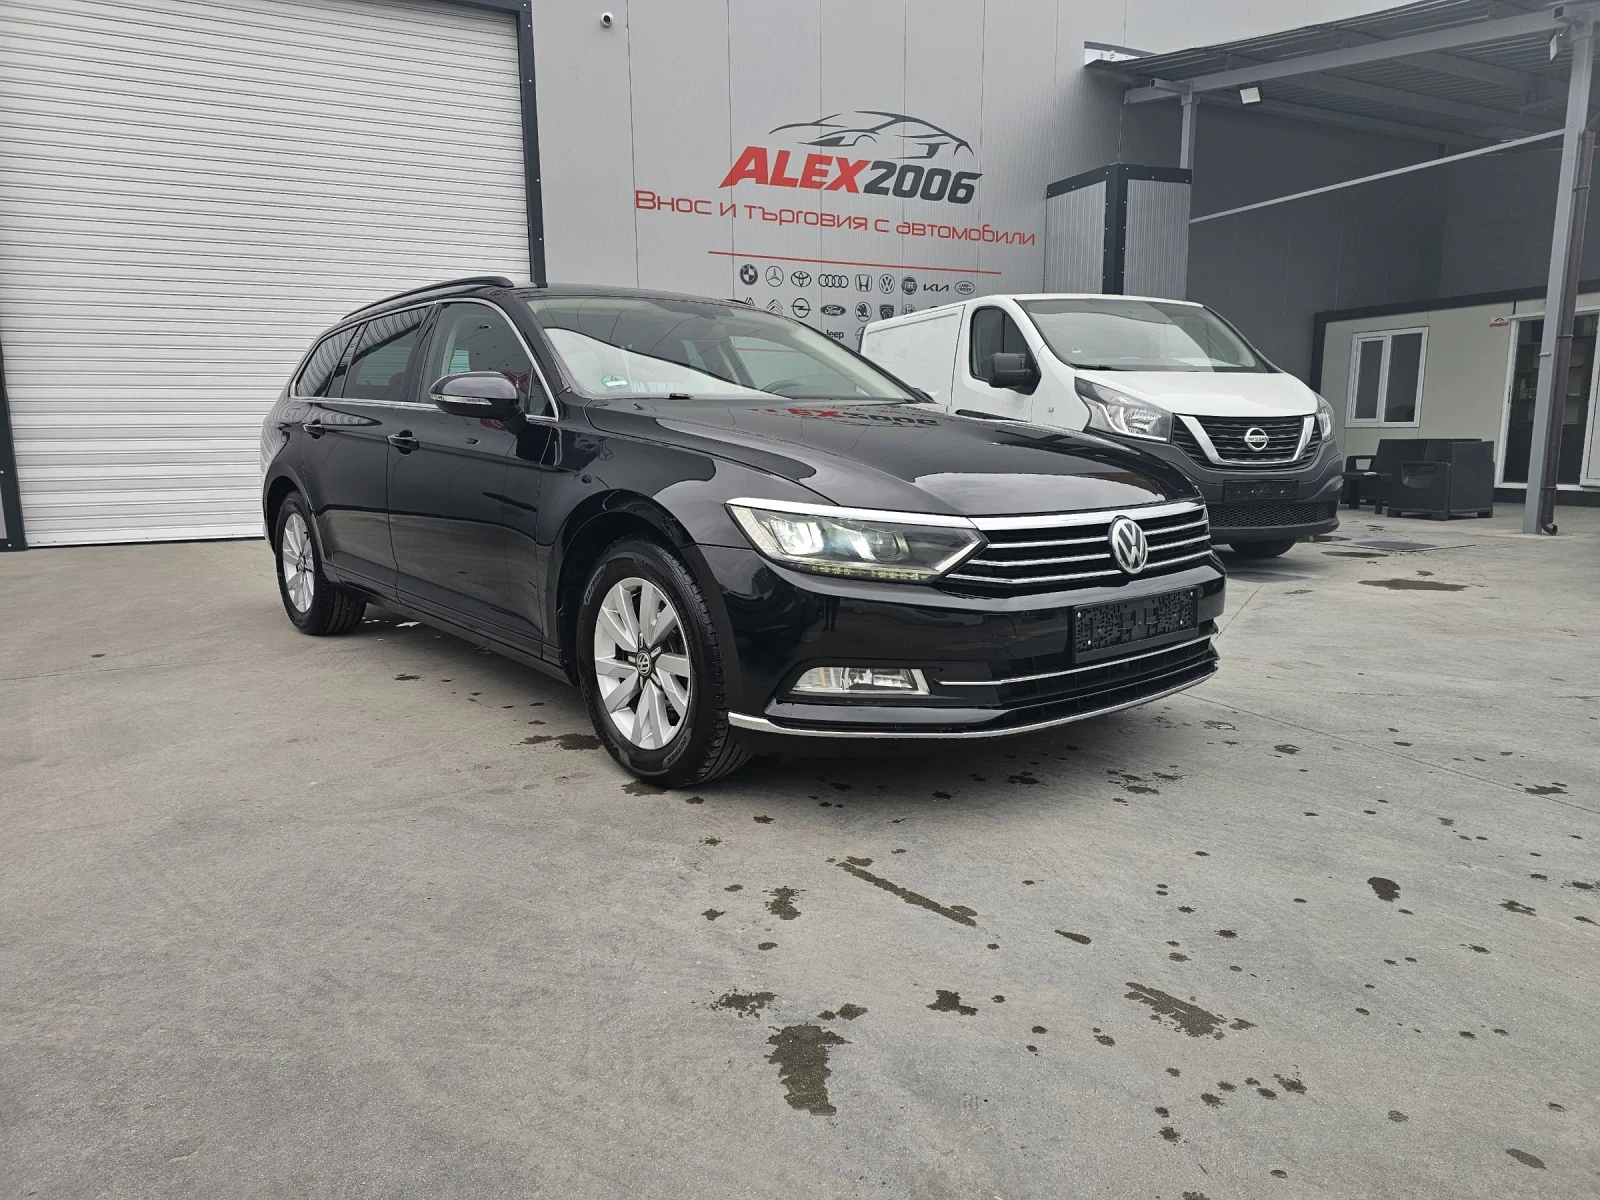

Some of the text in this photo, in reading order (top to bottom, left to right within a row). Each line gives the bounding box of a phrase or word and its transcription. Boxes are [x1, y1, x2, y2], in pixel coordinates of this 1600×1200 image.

[718, 145, 983, 205] ALEX2006
[634, 190, 712, 216] Внос
[743, 204, 868, 232] търговия
[874, 218, 890, 233] с
[895, 221, 1036, 246] автомобили
[824, 305, 842, 315] Ford
